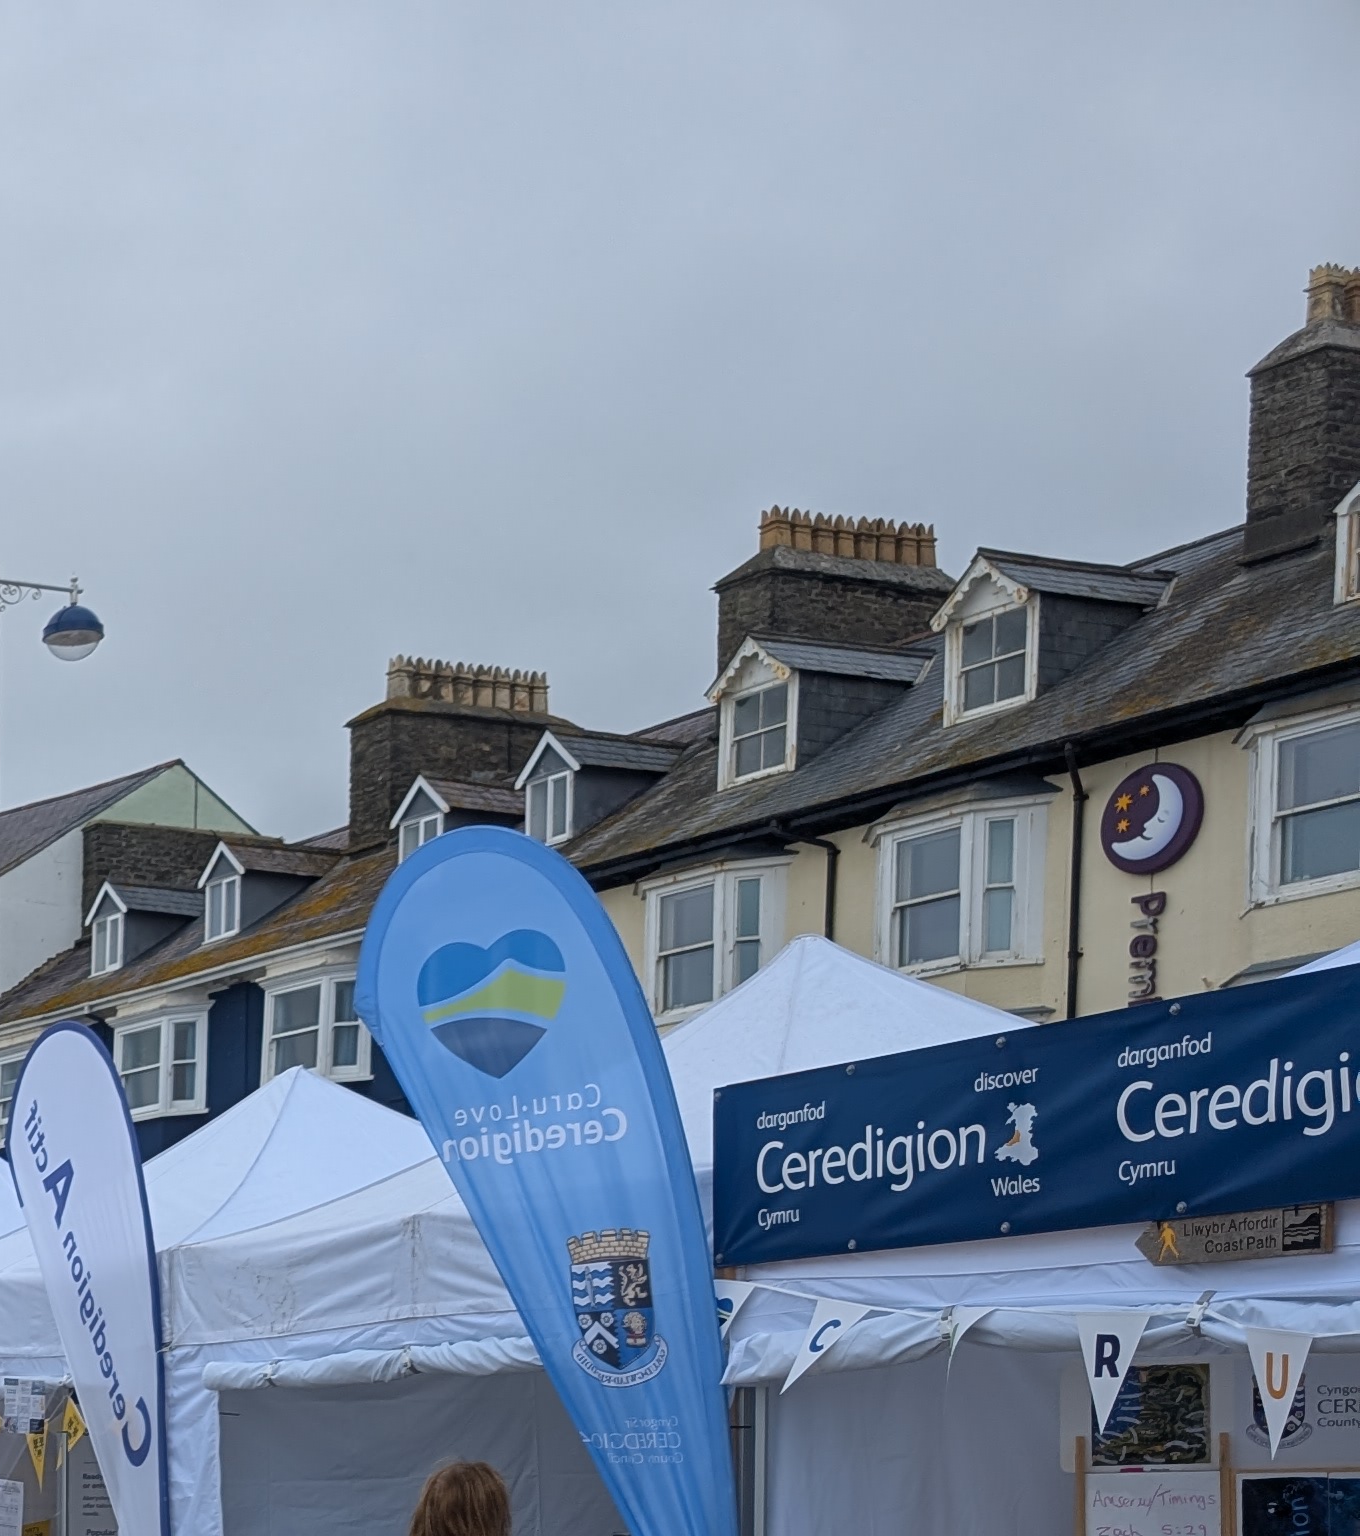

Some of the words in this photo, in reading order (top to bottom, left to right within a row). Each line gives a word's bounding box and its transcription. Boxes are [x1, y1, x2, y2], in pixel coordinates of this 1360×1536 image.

[1118, 1032, 1212, 1069] darganfod
[974, 1068, 1038, 1092] discover
[1117, 1052, 1360, 1143] Ceredigi
[757, 1101, 826, 1131] darganfod
[756, 1121, 986, 1194] Ceredigion
[1118, 1159, 1176, 1186] Cymru
[991, 1175, 1040, 1197] Wales
[757, 1208, 800, 1231] Cymru
[1183, 1222, 1226, 1238] Llwybr
[1228, 1215, 1278, 1232] Arfordir
[1204, 1239, 1244, 1254] Coast
[1246, 1234, 1277, 1250] Path
[809, 1308, 842, 1353] C
[1094, 1334, 1121, 1379] R
[1264, 1351, 1290, 1400] U
[1317, 1398, 1360, 1414] CER
[86, 1528, 117, 1536] Popular
